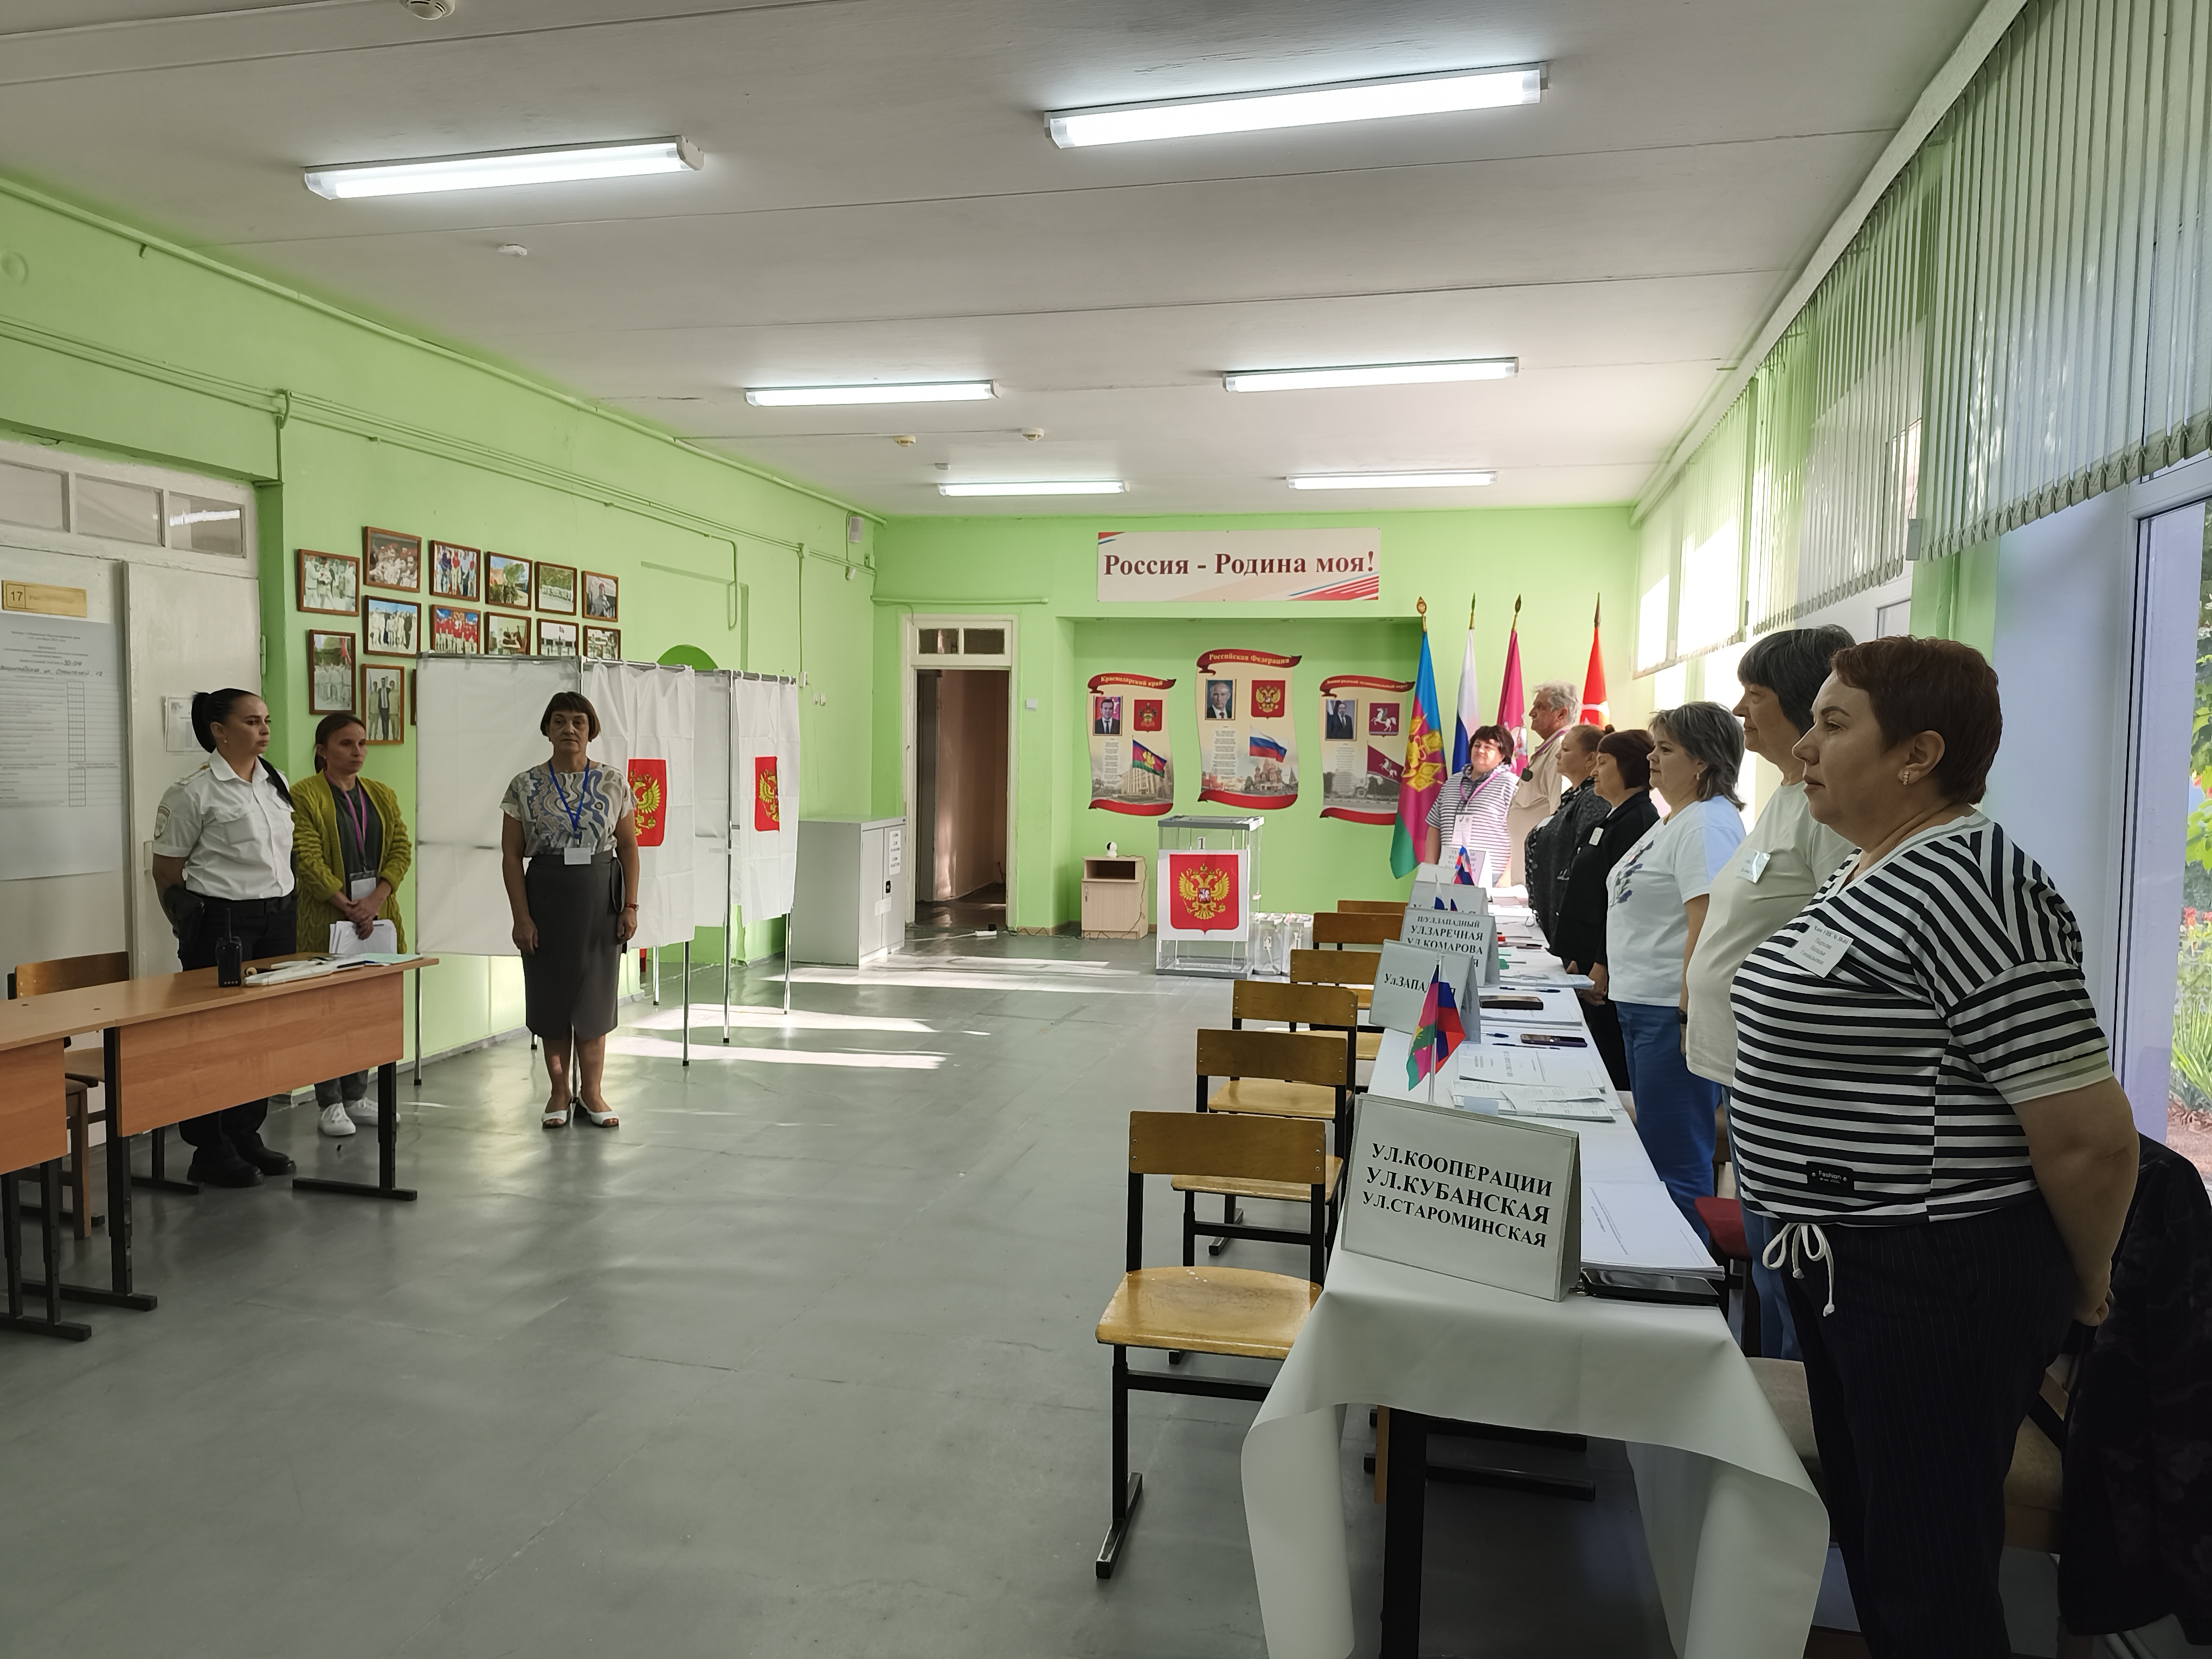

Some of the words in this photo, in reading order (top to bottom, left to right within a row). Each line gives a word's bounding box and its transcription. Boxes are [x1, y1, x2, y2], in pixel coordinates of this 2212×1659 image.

[1104, 555, 1189, 575] Россия
[1214, 553, 1306, 577] Родина
[1316, 551, 1374, 573] моя!
[10, 591, 23, 601] 17
[1209, 653, 1249, 661] Российская
[1101, 676, 1147, 686] Краснодарский
[1198, 838, 1204, 850] 1
[1411, 925, 1483, 941] УЛ.ЗАРЕЧНАЯ
[1407, 937, 1483, 955] УЛКОМАРОВА
[1372, 1143, 1553, 1198] УЛ.КООПЕРАЦИИ
[1366, 1166, 1551, 1225] УЛ.КУБАНСКАЯ
[1362, 1191, 1547, 1248] УЛ.СТАРОМИНСКАЯ
